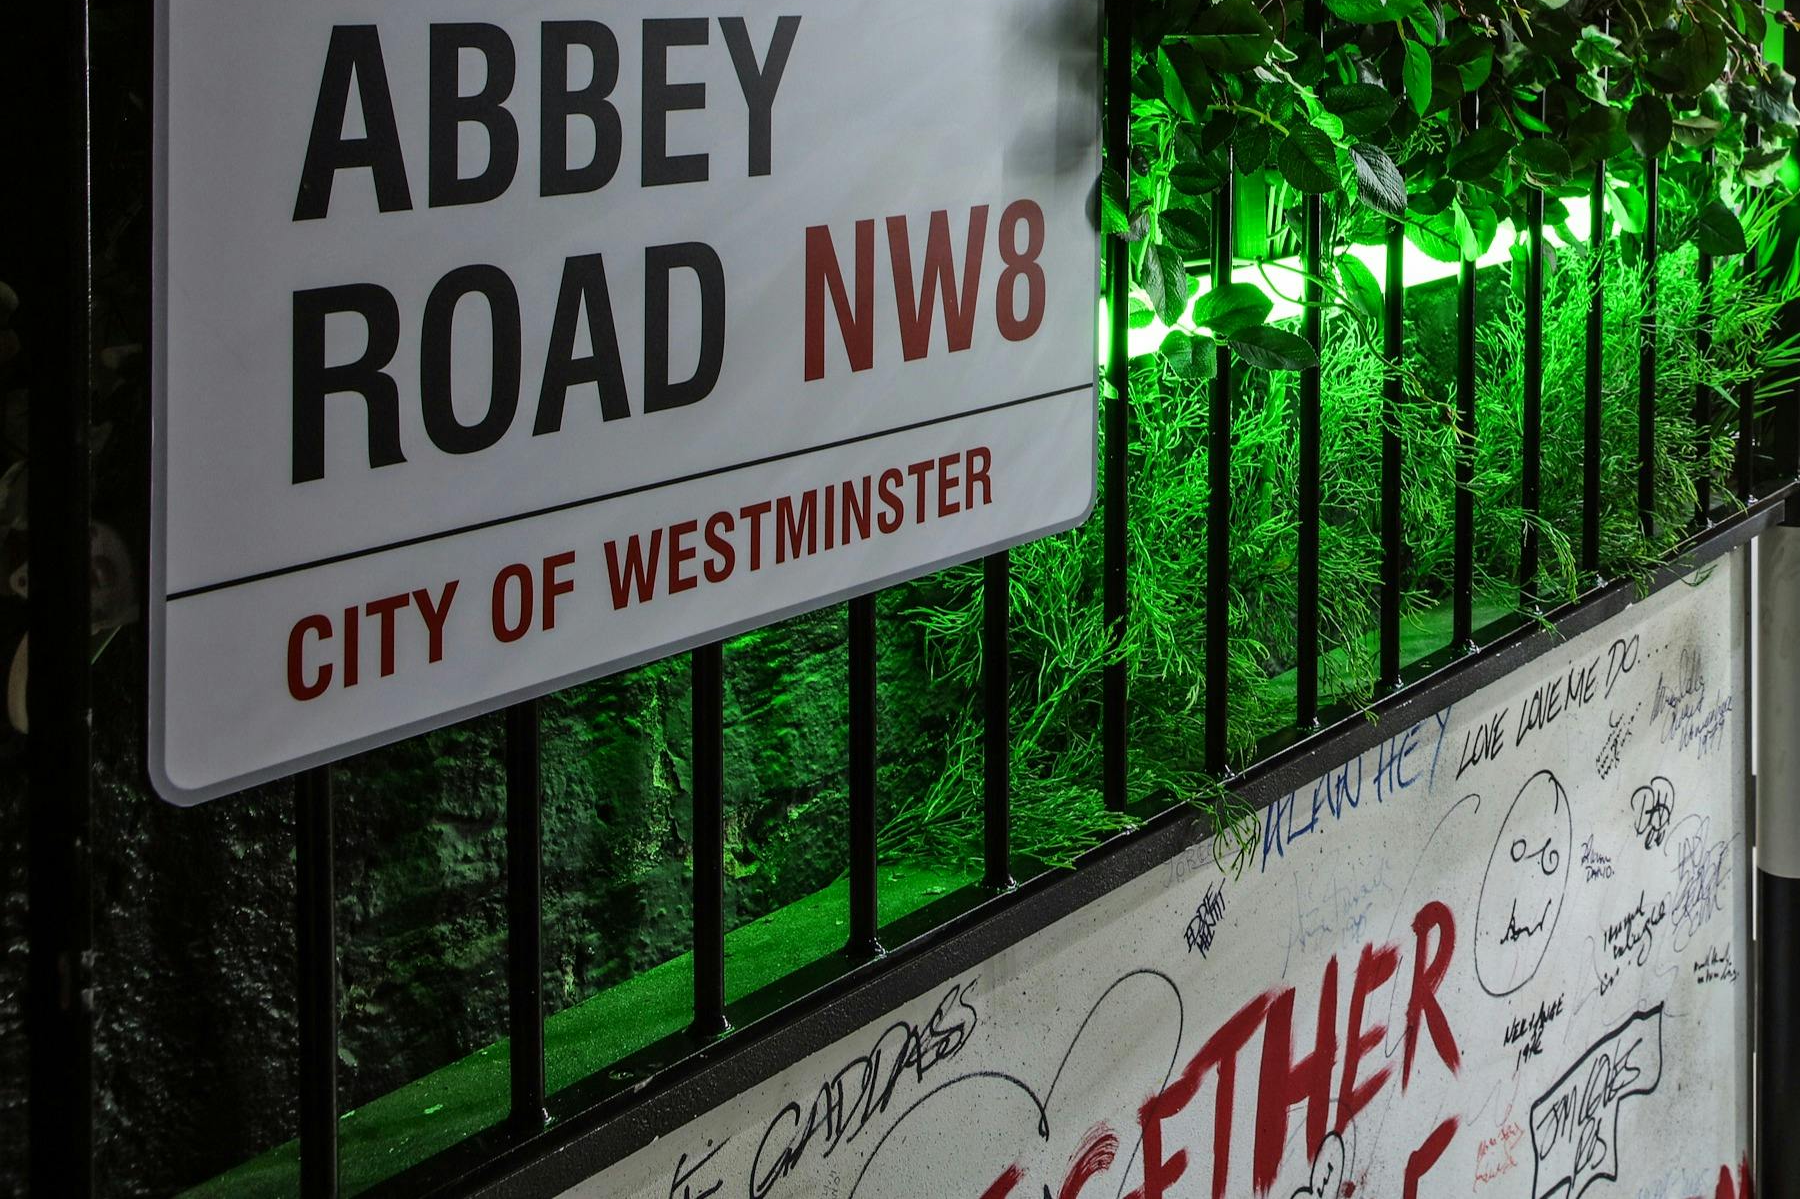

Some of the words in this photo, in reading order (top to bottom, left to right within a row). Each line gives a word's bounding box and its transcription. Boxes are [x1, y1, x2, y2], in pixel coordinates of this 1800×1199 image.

[291, 15, 802, 223] ABBEY
[291, 240, 727, 485] ROAD
[803, 198, 1047, 382] NW8
[286, 580, 460, 702] CITY
[490, 550, 577, 644] OF
[603, 446, 994, 610] WESTMINSTER
[1455, 707, 1509, 782] LOVE
[1515, 676, 1563, 748] LOVE
[1563, 656, 1600, 711] ME
[978, 900, 1462, 1199] ETHER
